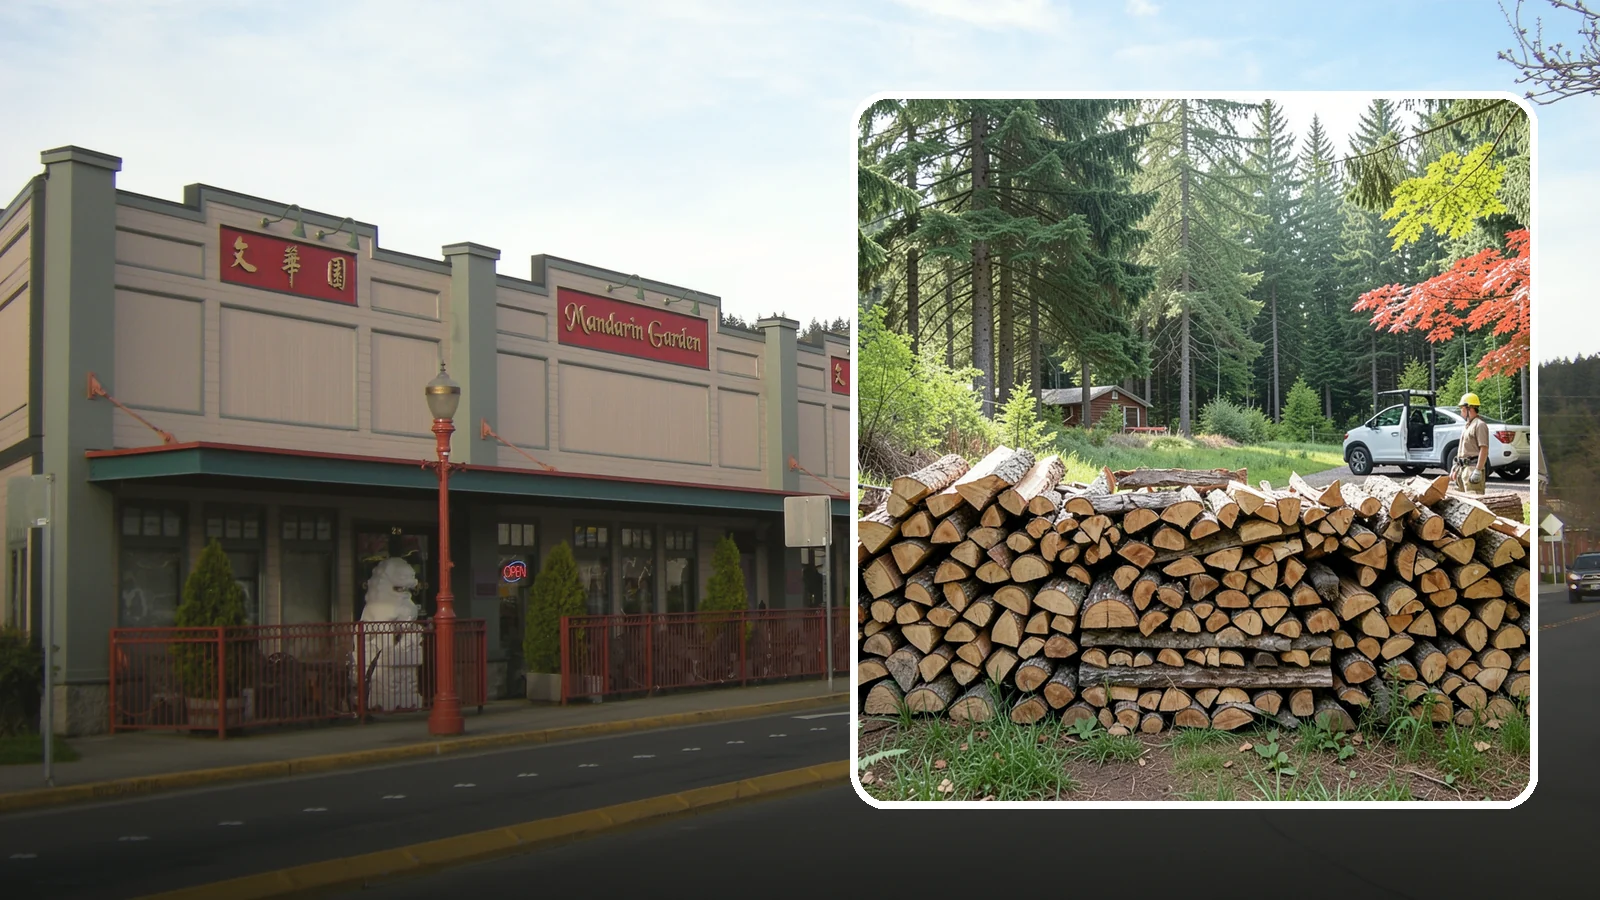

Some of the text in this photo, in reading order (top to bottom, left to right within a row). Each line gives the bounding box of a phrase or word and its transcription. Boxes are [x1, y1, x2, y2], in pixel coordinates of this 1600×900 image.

[231, 235, 346, 291] 文華園
[564, 302, 702, 352] Mandarin Garden
[503, 565, 527, 578] OPEN
